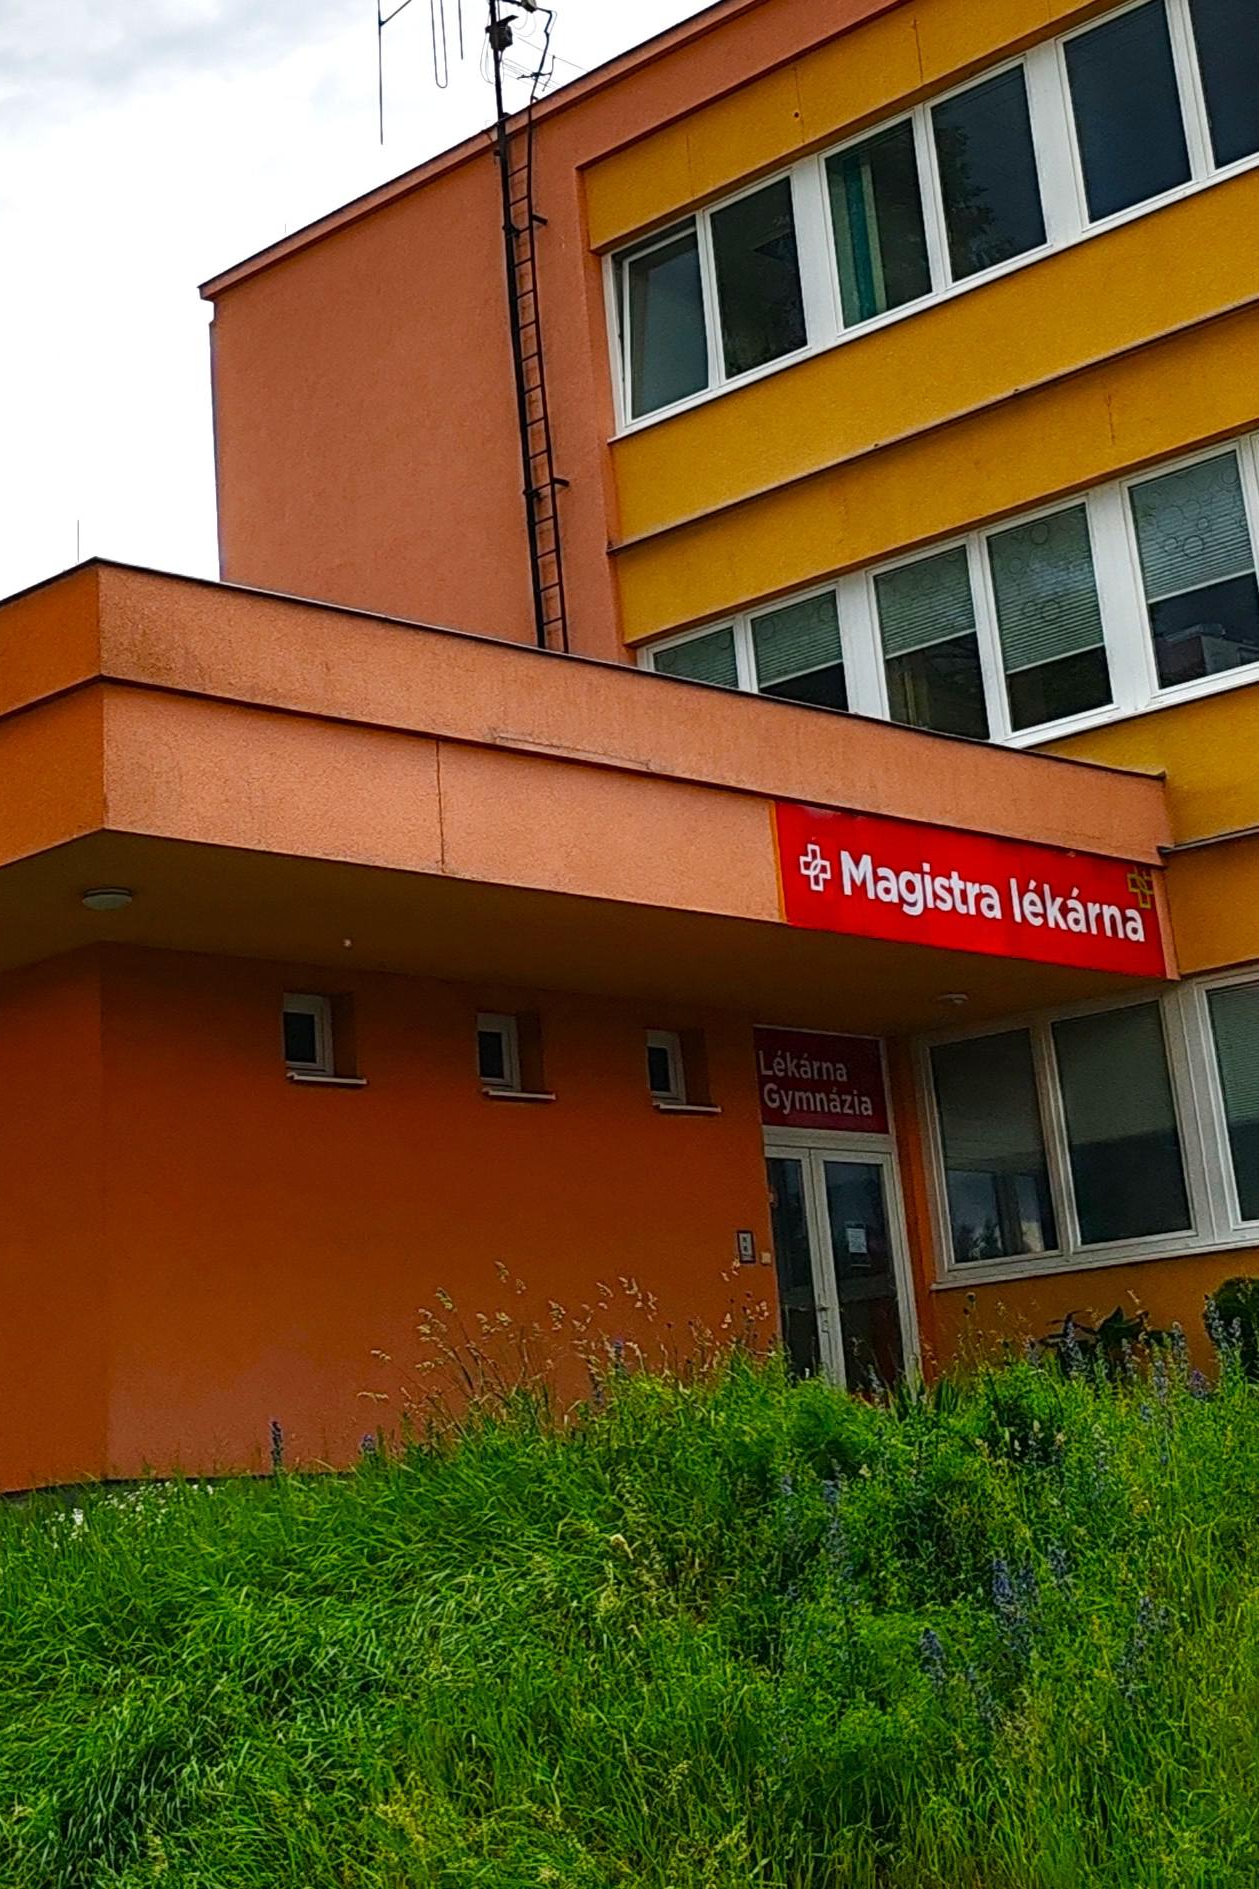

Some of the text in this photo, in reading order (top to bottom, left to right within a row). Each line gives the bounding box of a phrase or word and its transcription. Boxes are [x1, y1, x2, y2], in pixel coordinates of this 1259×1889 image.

[839, 849, 1145, 942] Magistra lékárna
[758, 1049, 848, 1082] Lékárna
[763, 1082, 873, 1115] Gymnázia
